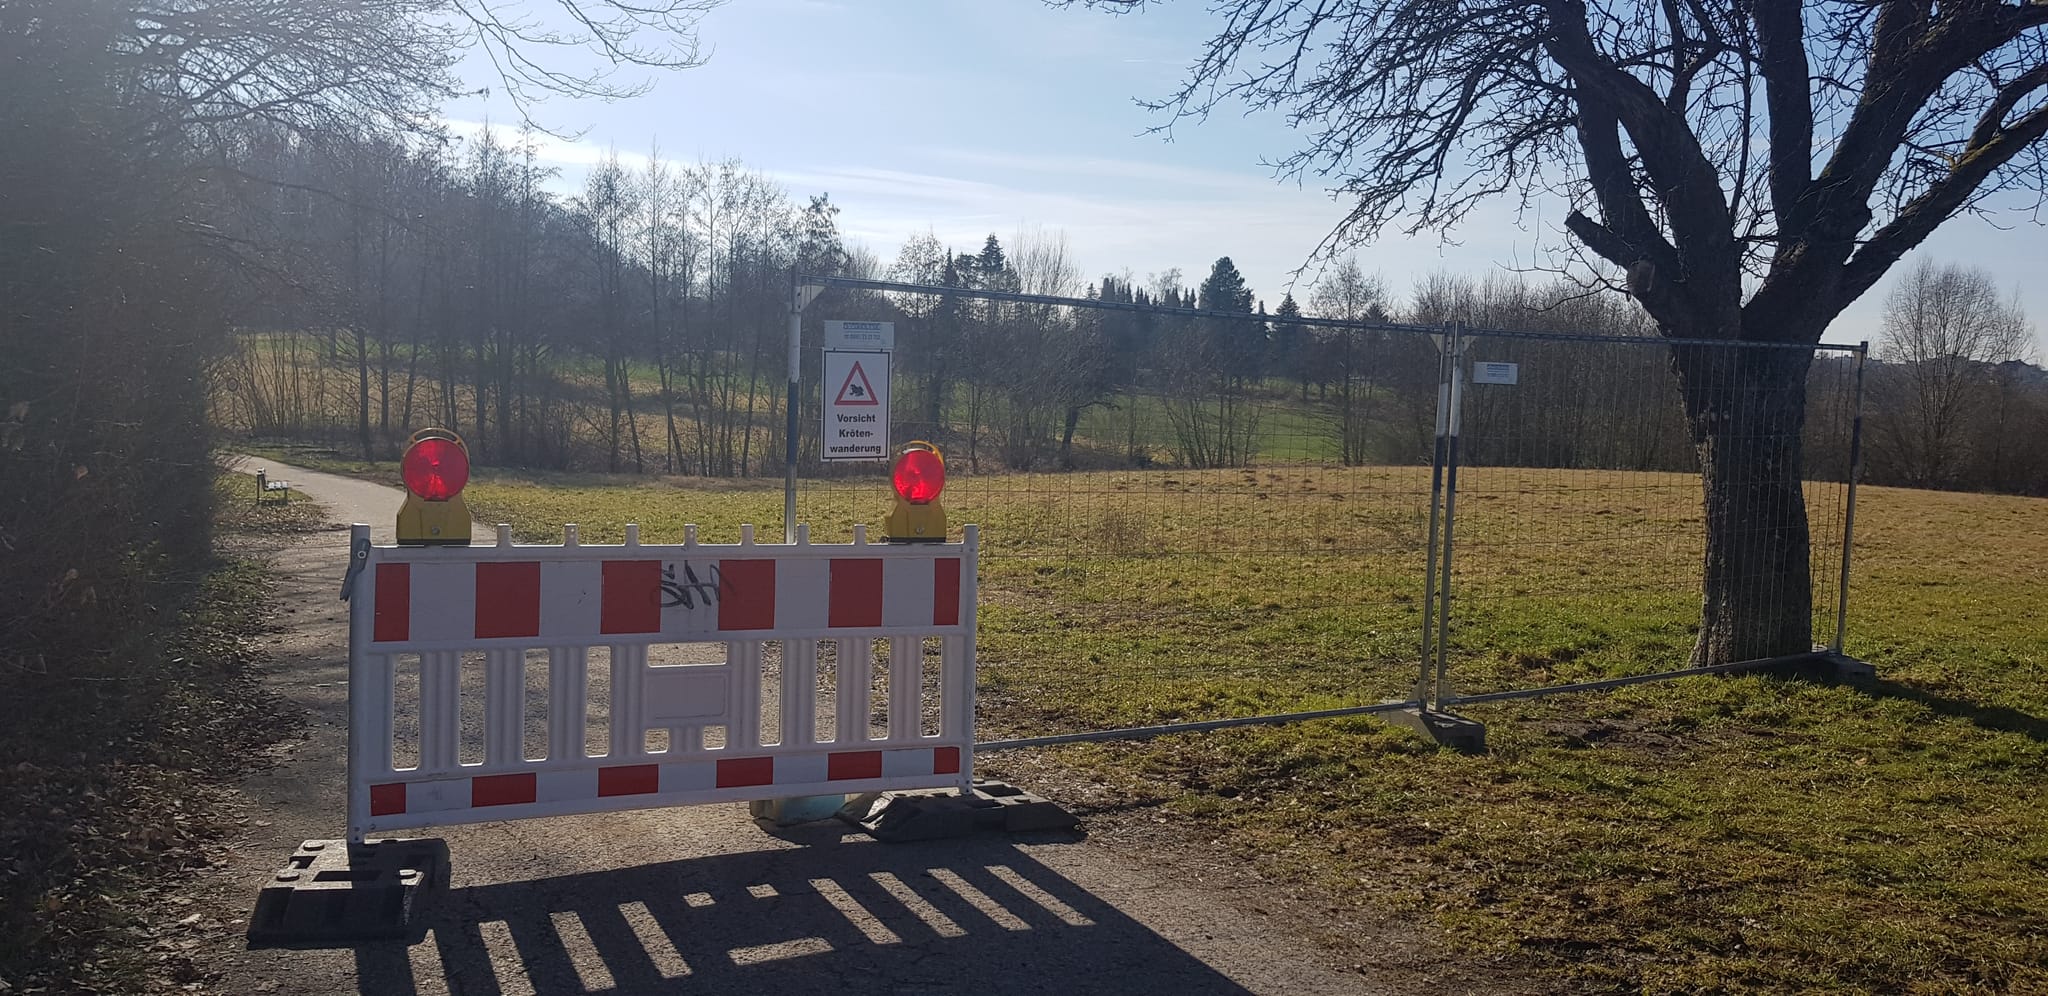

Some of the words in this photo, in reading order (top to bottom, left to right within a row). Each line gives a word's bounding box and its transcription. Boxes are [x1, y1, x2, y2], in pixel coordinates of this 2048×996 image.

[837, 414, 876, 422] Vorsicht
[839, 429, 874, 438] Kröten-
[830, 444, 881, 454] wanderung
